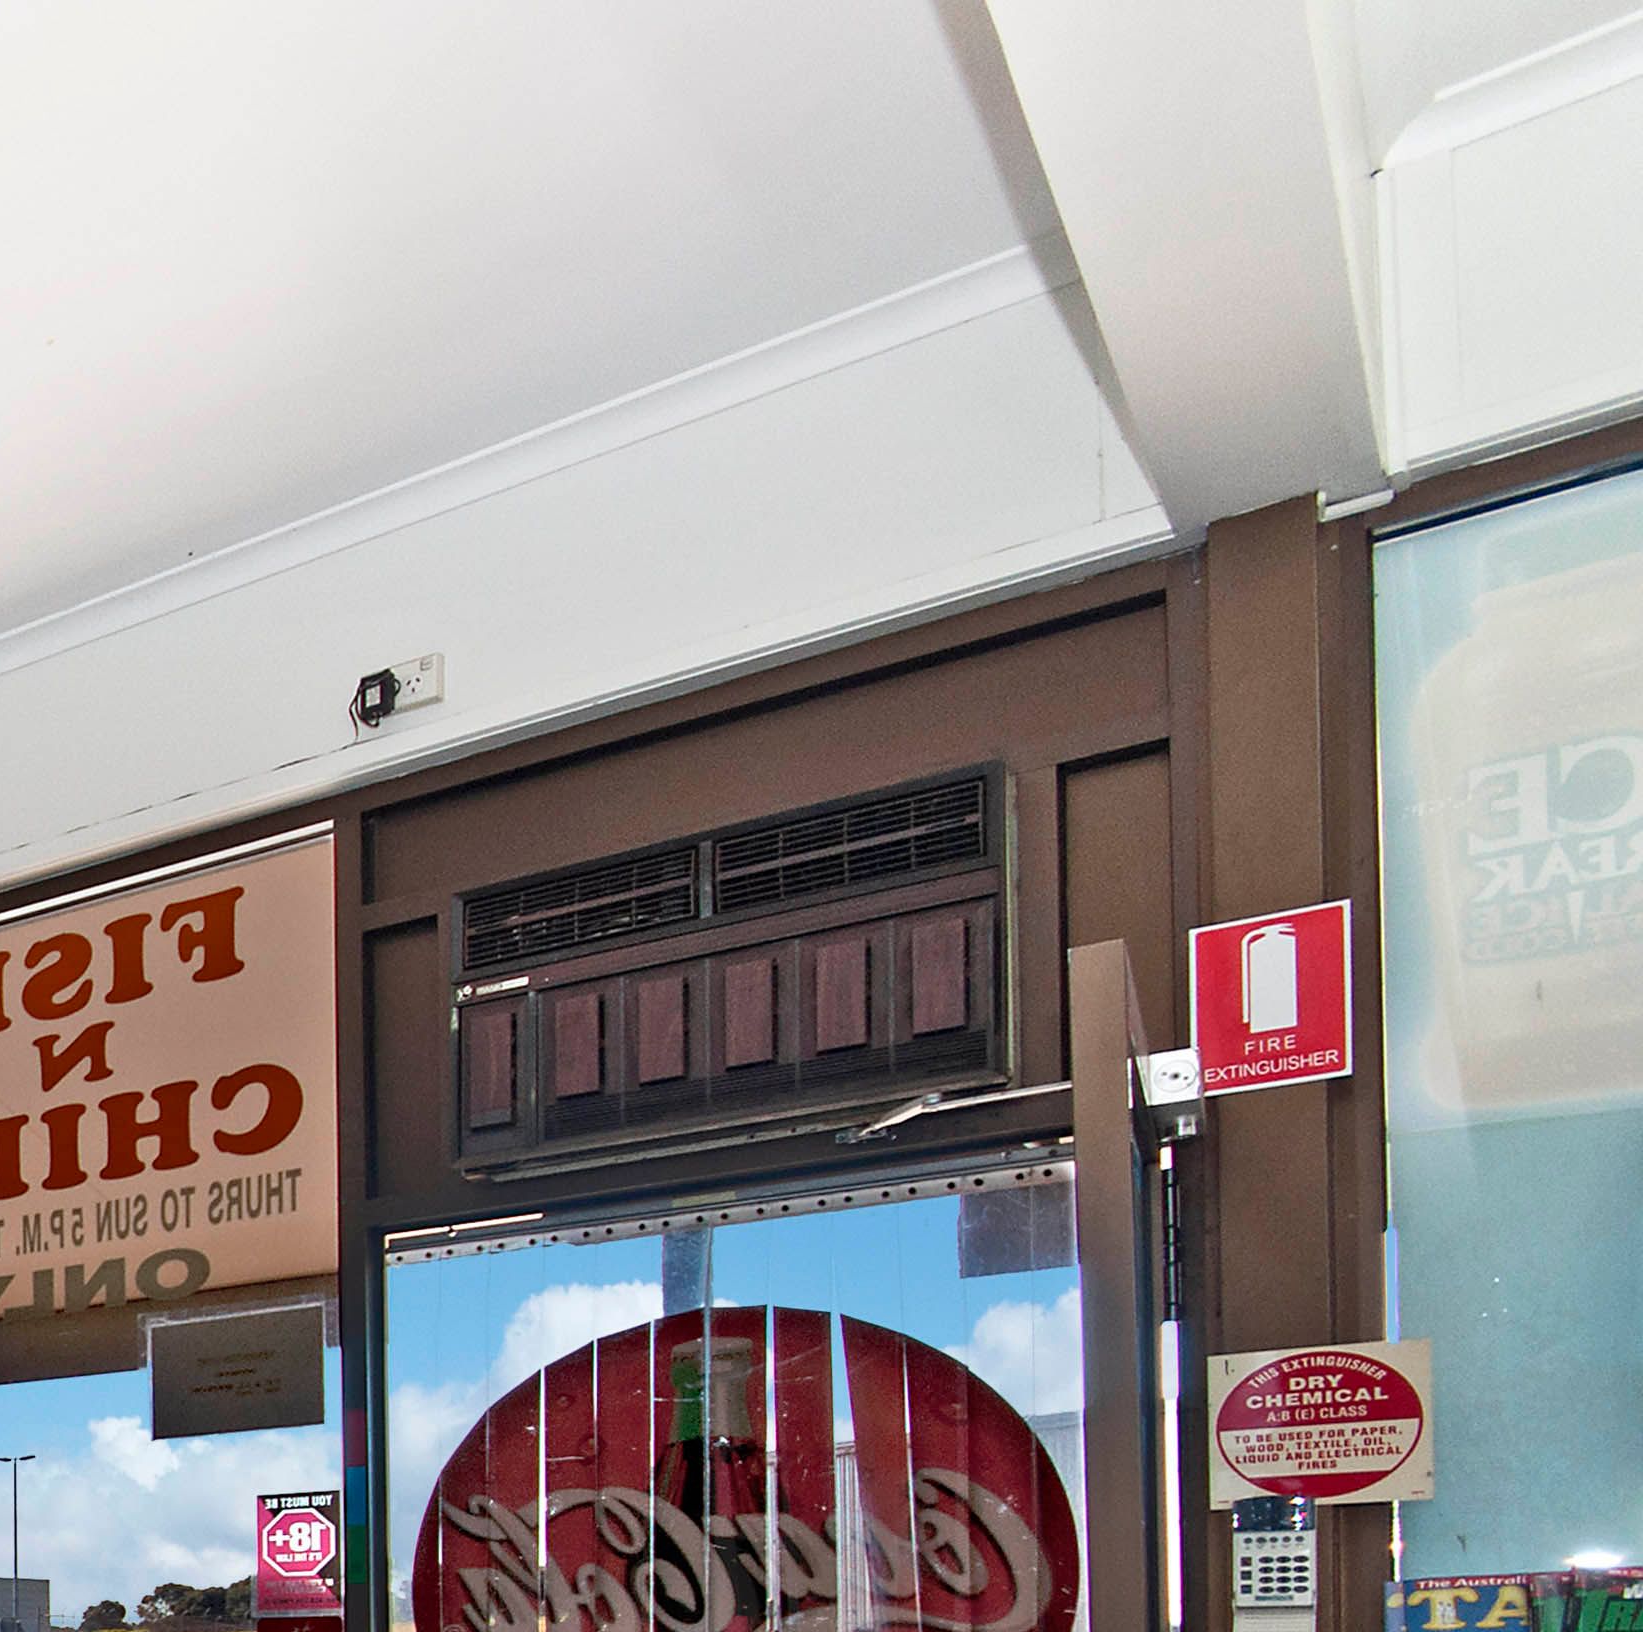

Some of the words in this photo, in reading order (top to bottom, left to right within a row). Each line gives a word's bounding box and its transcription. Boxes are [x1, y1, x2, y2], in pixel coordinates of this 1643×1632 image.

[1244, 1034, 1297, 1056] FIRE
[1203, 1049, 1339, 1083] EXTINGUISHER
[1248, 1367, 1278, 1389] THIS
[1282, 1355, 1387, 1381] EXTINGUISHER
[1288, 1374, 1344, 1392] DRY
[1245, 1387, 1389, 1410] CHEMICAL
[1319, 1404, 1369, 1419] CLASS
[1235, 1435, 1250, 1445] TO
[1256, 1433, 1272, 1443] BE
[1278, 1430, 1313, 1442] USED
[1319, 1428, 1346, 1438] FOR
[1235, 1454, 1280, 1465] LIQUID
[1285, 1451, 1313, 1461] AND
[1317, 1446, 1404, 1460] ELECTRICAL
[1297, 1459, 1339, 1470] FIRES
[1418, 1580, 1451, 1589] The
